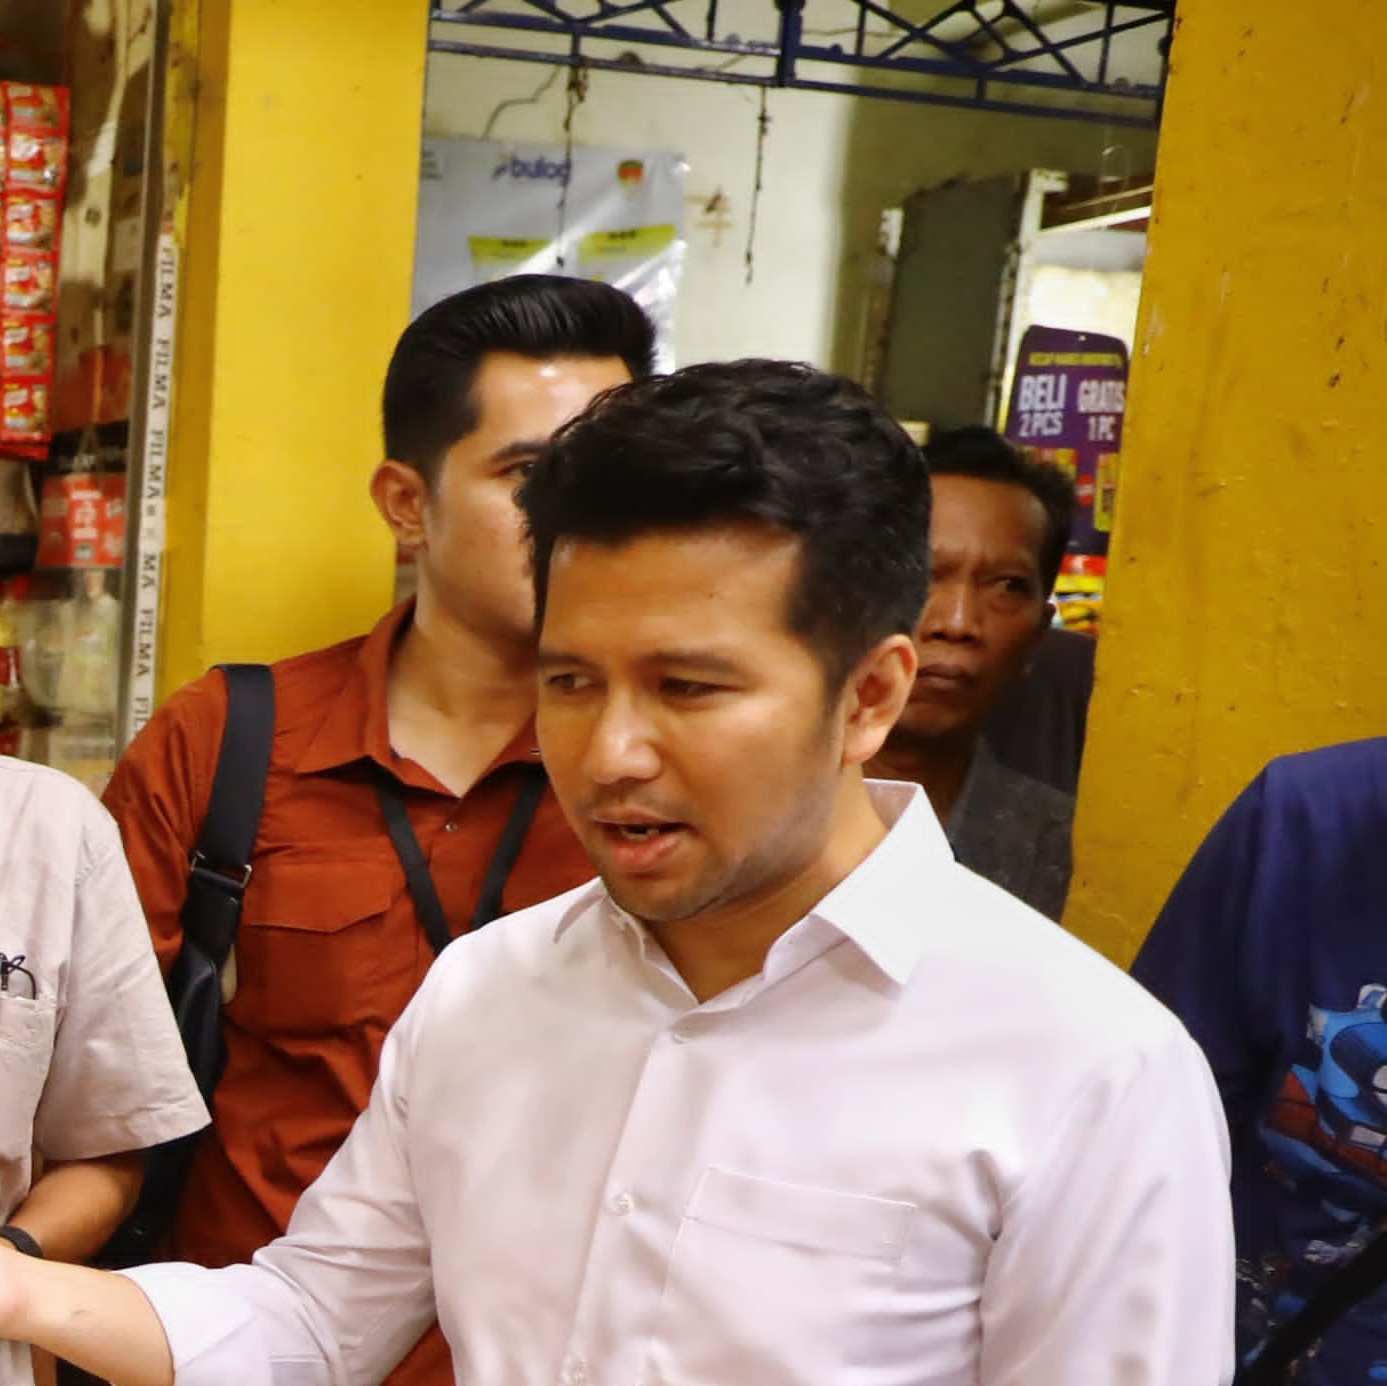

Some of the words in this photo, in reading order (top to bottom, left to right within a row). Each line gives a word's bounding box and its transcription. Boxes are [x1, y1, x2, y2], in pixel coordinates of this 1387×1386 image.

[158, 247, 175, 318] FILMA
[152, 339, 170, 408] FILMA
[1017, 373, 1068, 412] BELI
[1031, 411, 1064, 437] PCS
[146, 430, 165, 500] FILMA
[136, 608, 154, 677] FILMA
